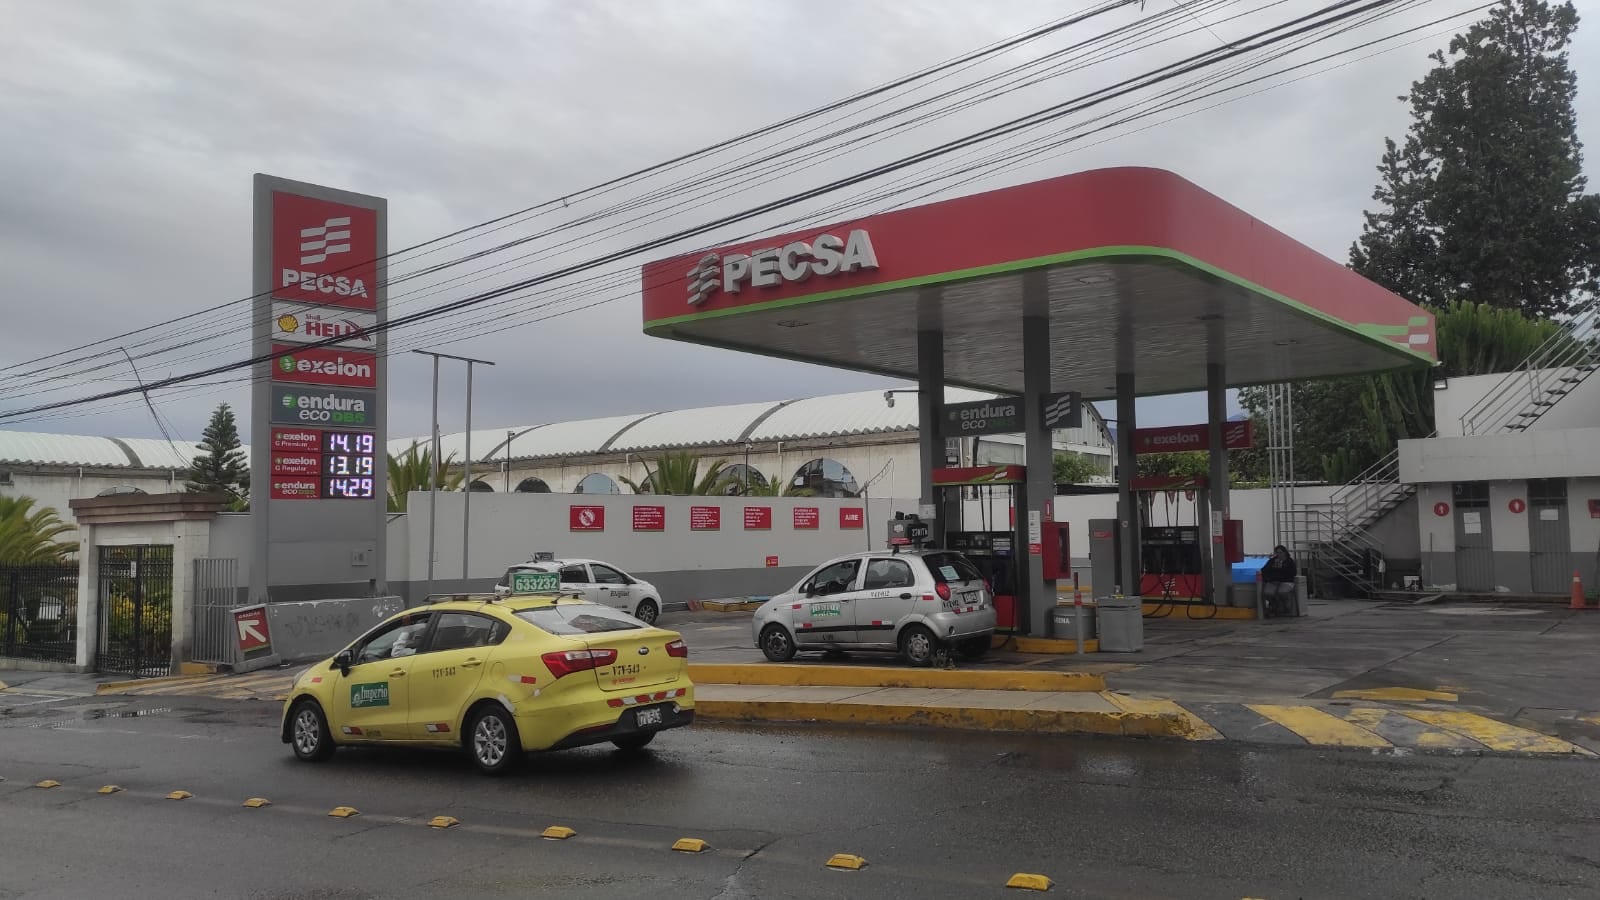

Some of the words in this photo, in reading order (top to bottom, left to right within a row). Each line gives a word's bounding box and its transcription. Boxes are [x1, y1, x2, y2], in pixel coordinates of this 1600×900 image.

[723, 229, 879, 293] PECSA
[282, 268, 368, 299] PECSA
[297, 357, 371, 378] exelon
[298, 394, 365, 411] endura
[299, 409, 331, 421] eco
[960, 404, 1016, 419] endura
[961, 419, 986, 430] eco
[282, 432, 316, 442] exelon
[330, 434, 373, 453] 14.19
[1153, 432, 1199, 444] exelon
[282, 457, 316, 466] exelon
[282, 481, 315, 489] endura
[330, 478, 372, 497] 14.29
[516, 577, 557, 591] 633232
[361, 684, 388, 702] Imperio
